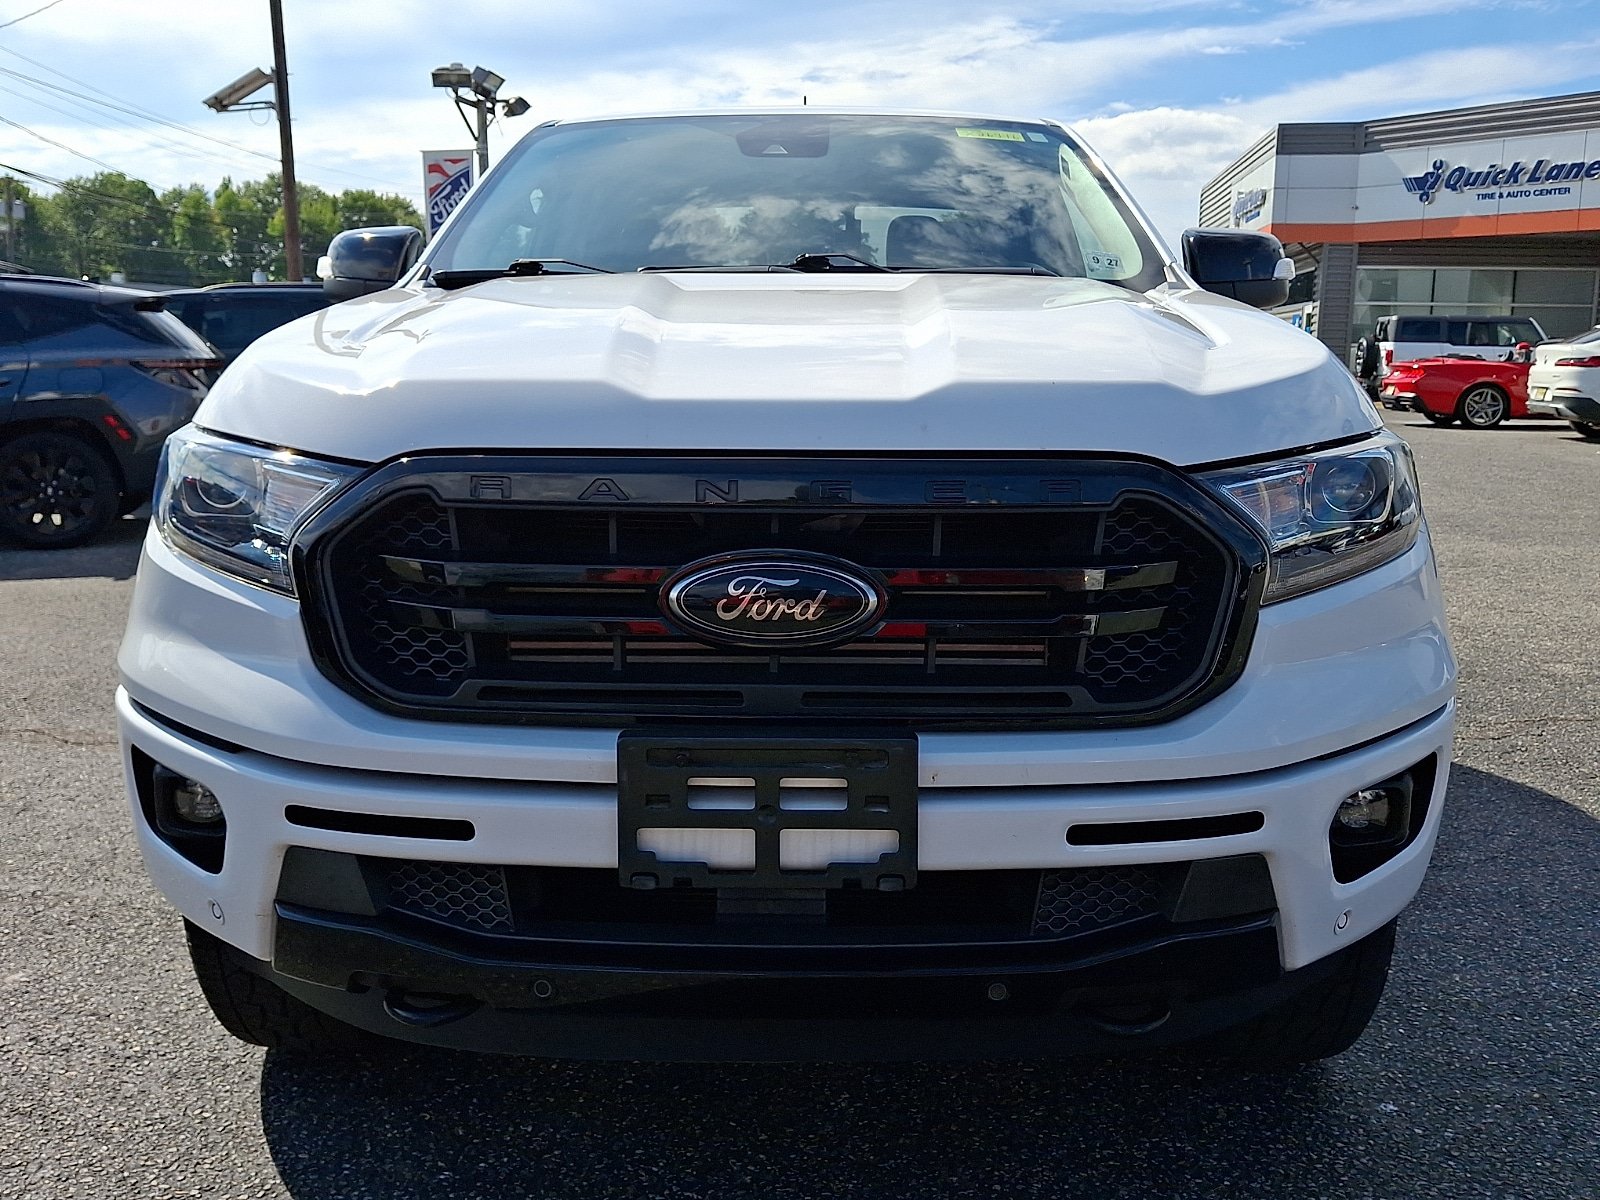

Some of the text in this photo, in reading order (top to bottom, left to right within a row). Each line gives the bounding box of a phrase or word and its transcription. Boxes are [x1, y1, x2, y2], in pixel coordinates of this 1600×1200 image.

[1444, 159, 1600, 193] Quick Lane
[430, 177, 471, 224] Ford
[1476, 192, 1496, 201] TIRE
[1505, 188, 1531, 199] AUTO
[1533, 186, 1571, 197] CENTER
[1106, 258, 1119, 267] 27
[469, 475, 1082, 504] RANGER
[716, 576, 827, 621] Ford
